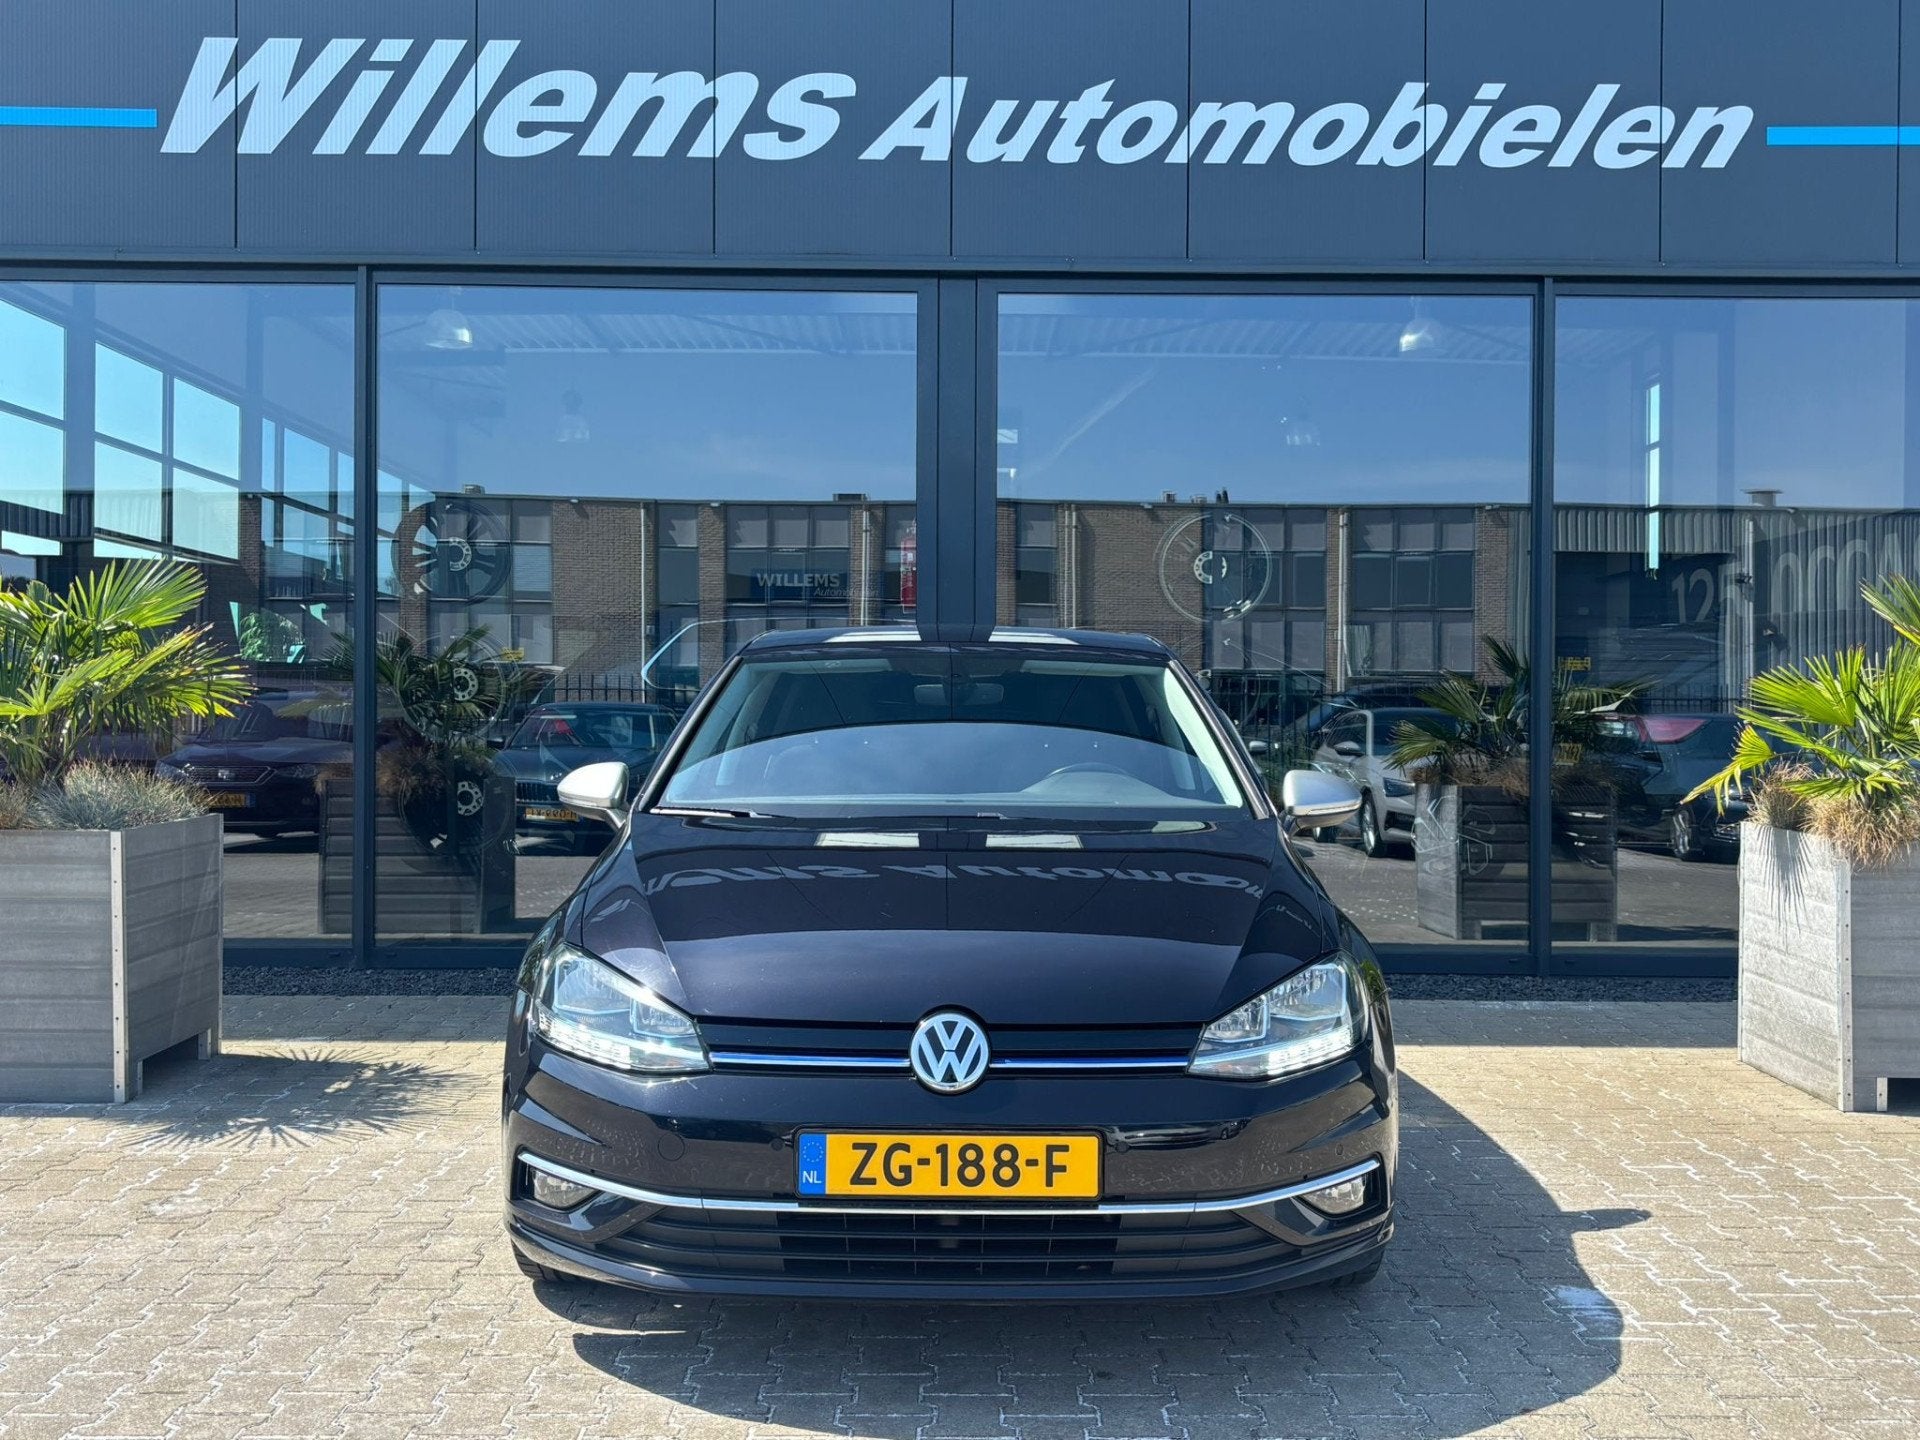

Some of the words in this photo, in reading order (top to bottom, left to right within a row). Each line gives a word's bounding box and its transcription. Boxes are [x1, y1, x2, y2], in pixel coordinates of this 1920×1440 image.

[160, 37, 857, 160] Willems
[858, 76, 1754, 169] Automobielen
[756, 573, 841, 588] WILLEMS
[802, 1170, 822, 1184] NL
[849, 1142, 1070, 1188] ZG-188-F
